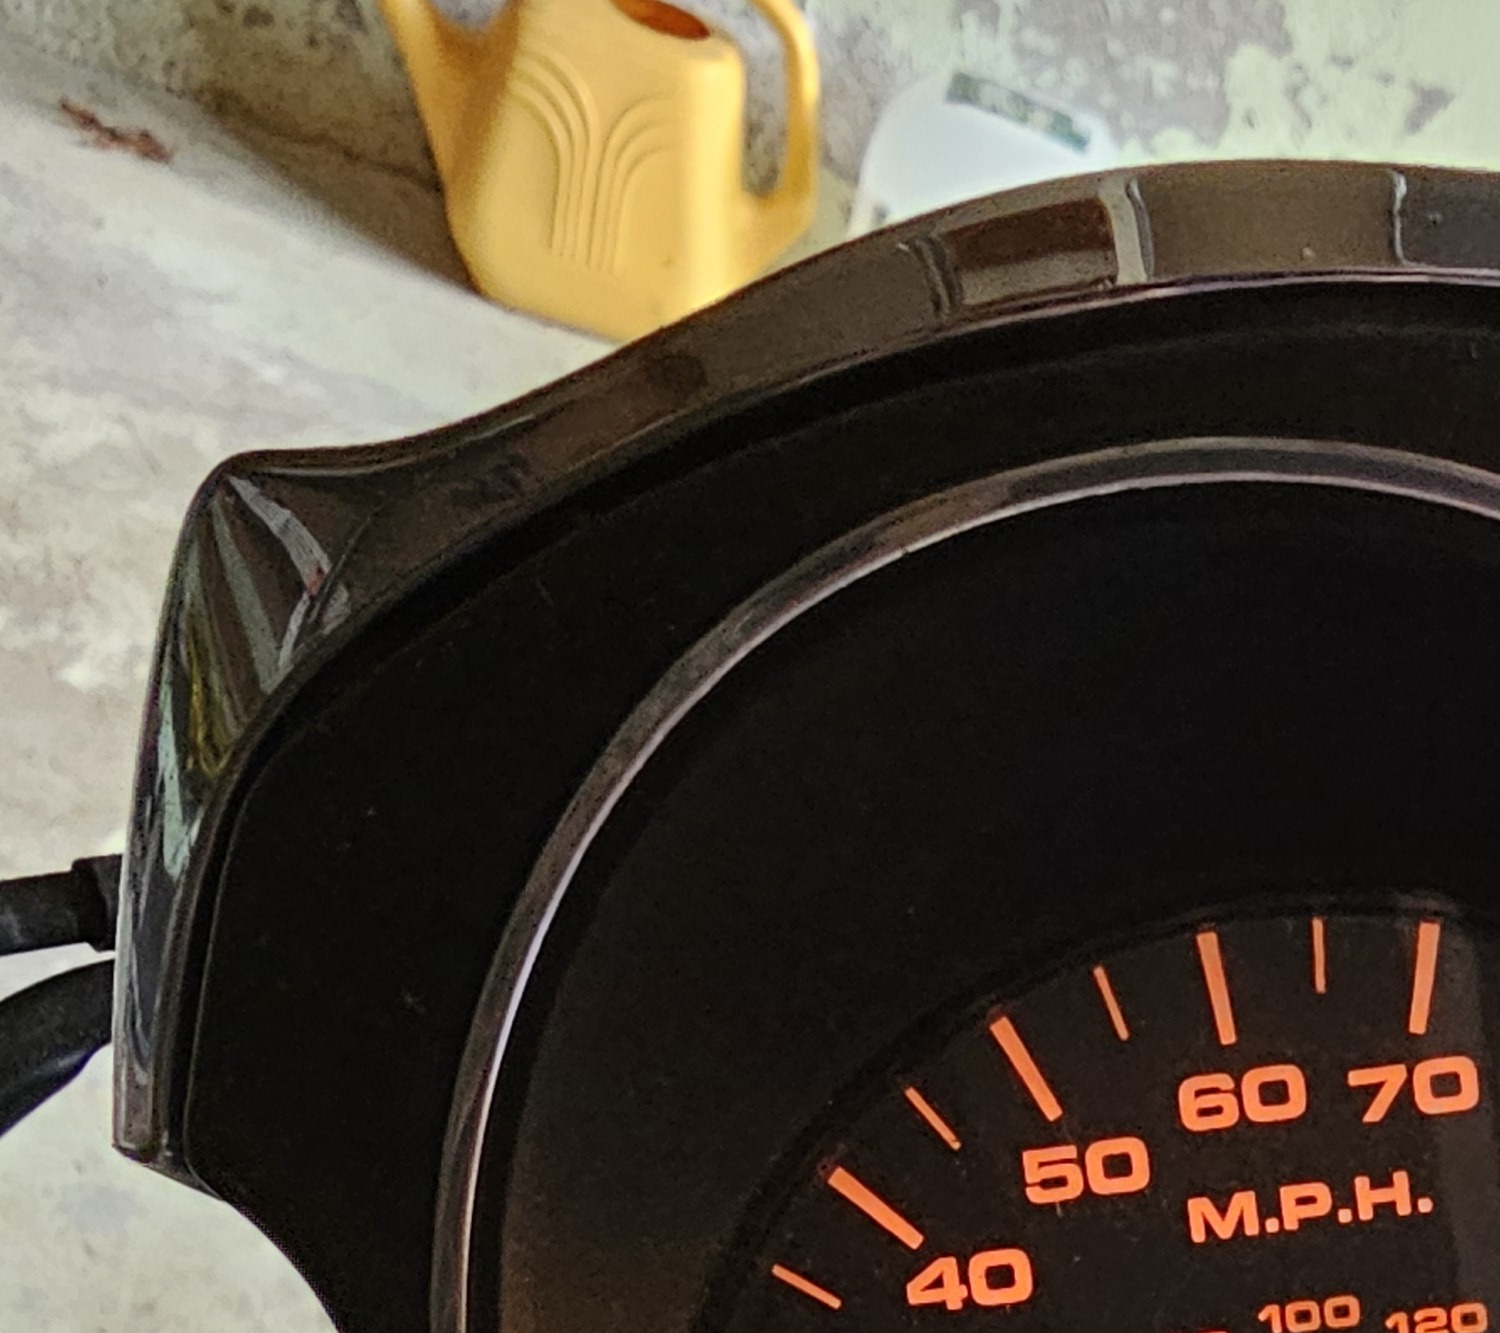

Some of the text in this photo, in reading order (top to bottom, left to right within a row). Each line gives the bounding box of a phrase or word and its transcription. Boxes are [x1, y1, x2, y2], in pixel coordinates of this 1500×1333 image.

[1178, 1065, 1306, 1131] 60
[1348, 1056, 1479, 1122] 70
[1022, 1137, 1150, 1206] 50
[1187, 1171, 1433, 1243] M.P.H.
[906, 1249, 1033, 1310] 40
